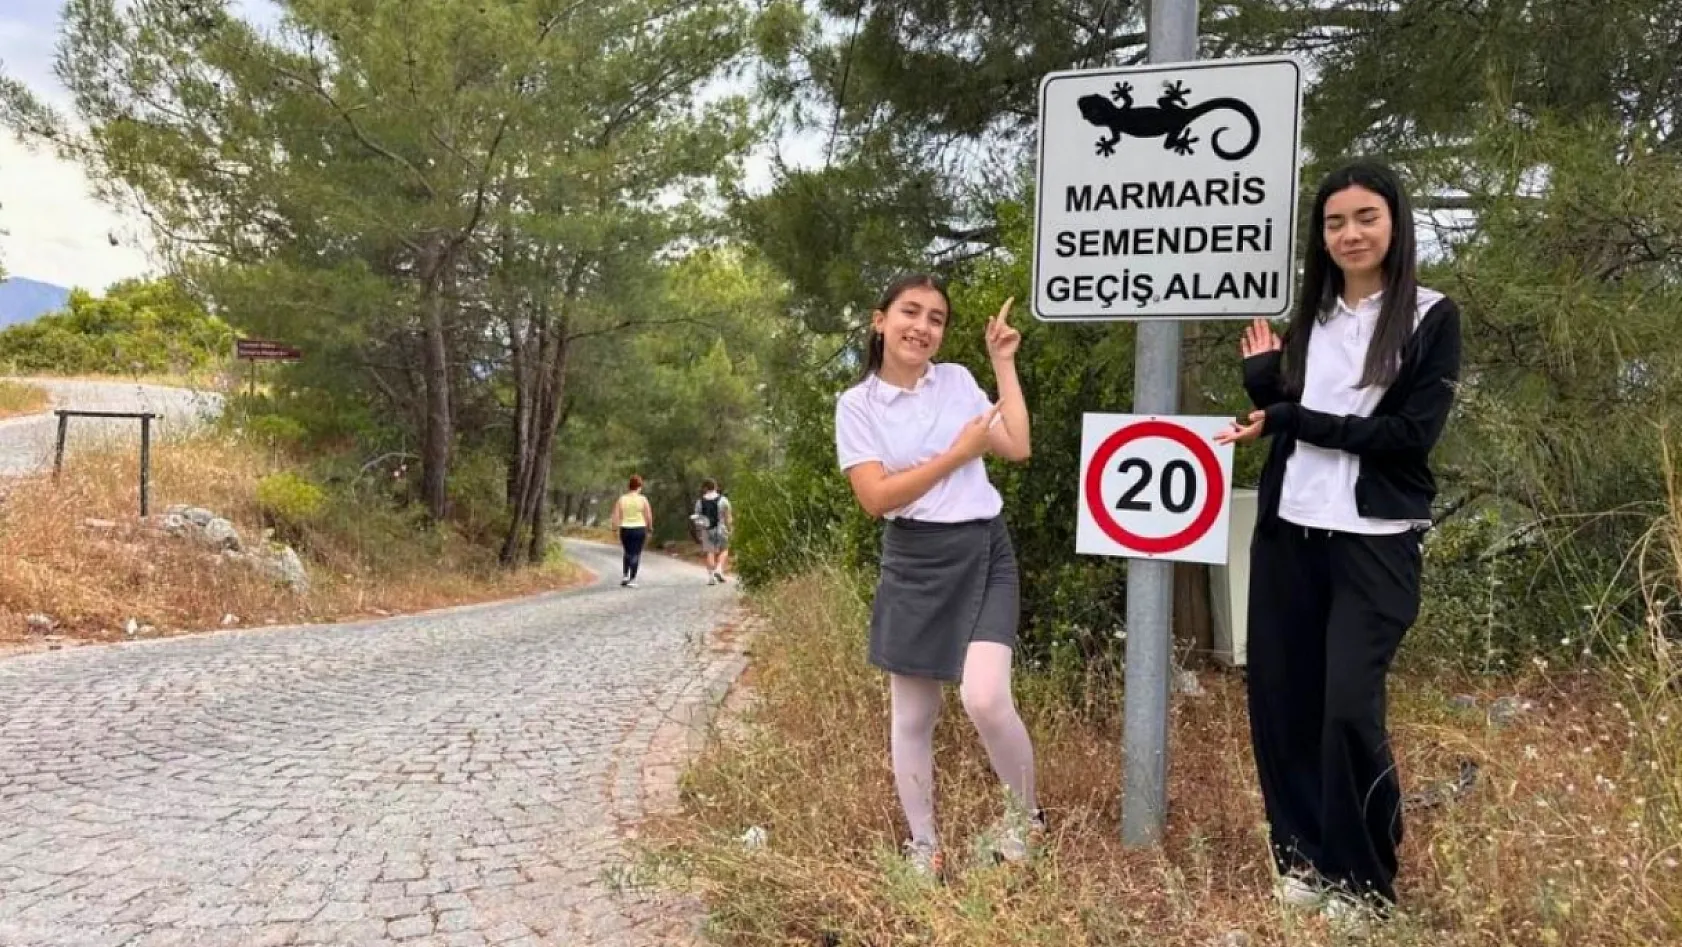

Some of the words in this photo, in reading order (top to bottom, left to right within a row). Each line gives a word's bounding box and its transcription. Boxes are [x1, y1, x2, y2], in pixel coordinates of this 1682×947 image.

[1066, 172, 1266, 212] MARMARİS
[1056, 218, 1272, 257] SEMENDERİ
[1047, 269, 1153, 308] GEÇİŞ
[1164, 272, 1279, 300] ALANI
[1116, 457, 1196, 514] 20
